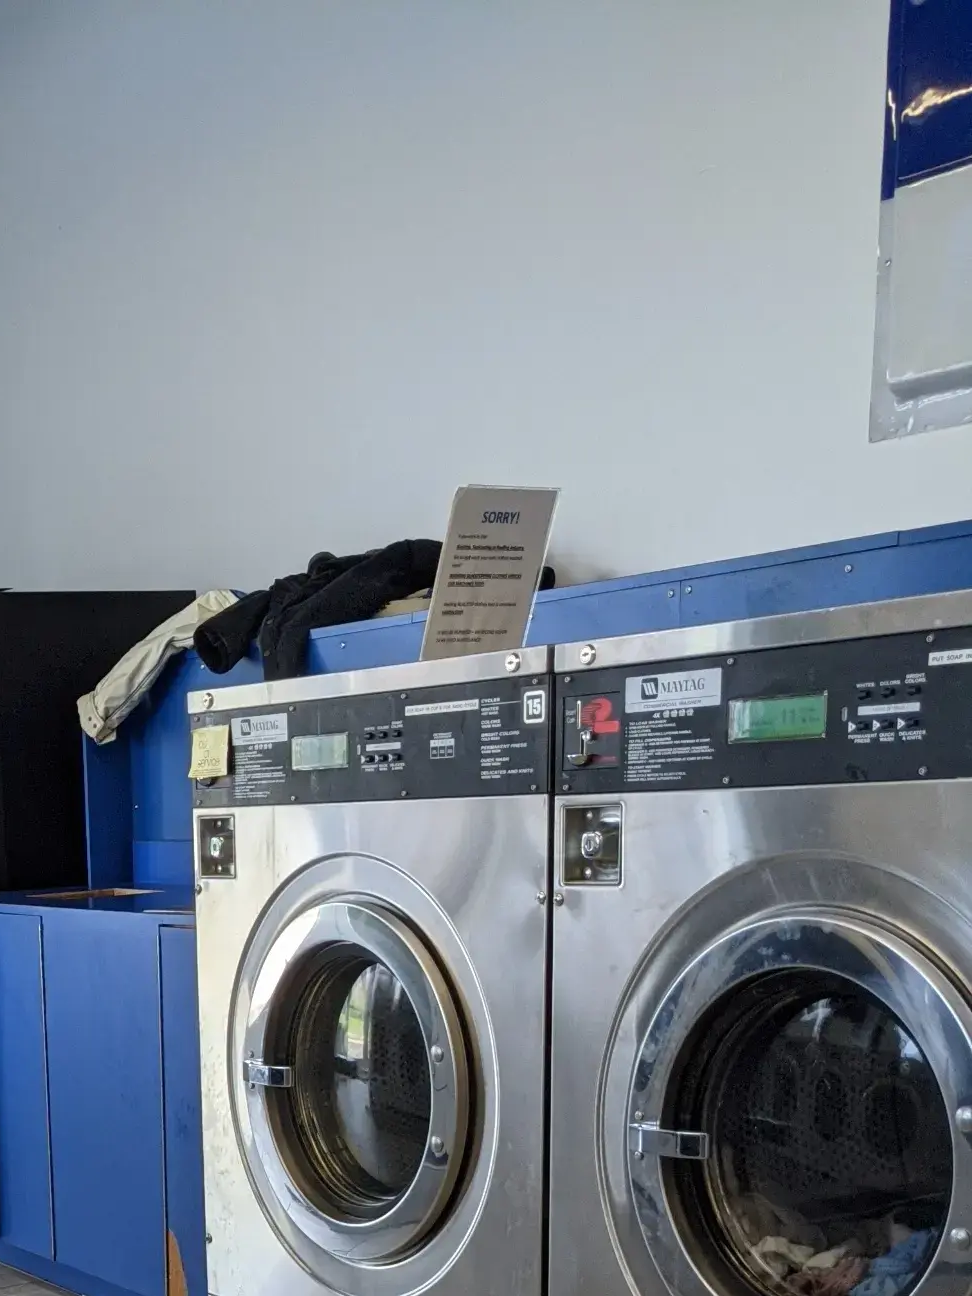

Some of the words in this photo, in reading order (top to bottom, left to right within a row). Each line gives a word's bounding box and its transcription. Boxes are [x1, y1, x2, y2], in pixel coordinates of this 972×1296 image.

[481, 511, 520, 524] SORRY!
[660, 678, 705, 694] MAYTAG
[527, 698, 541, 716] 15
